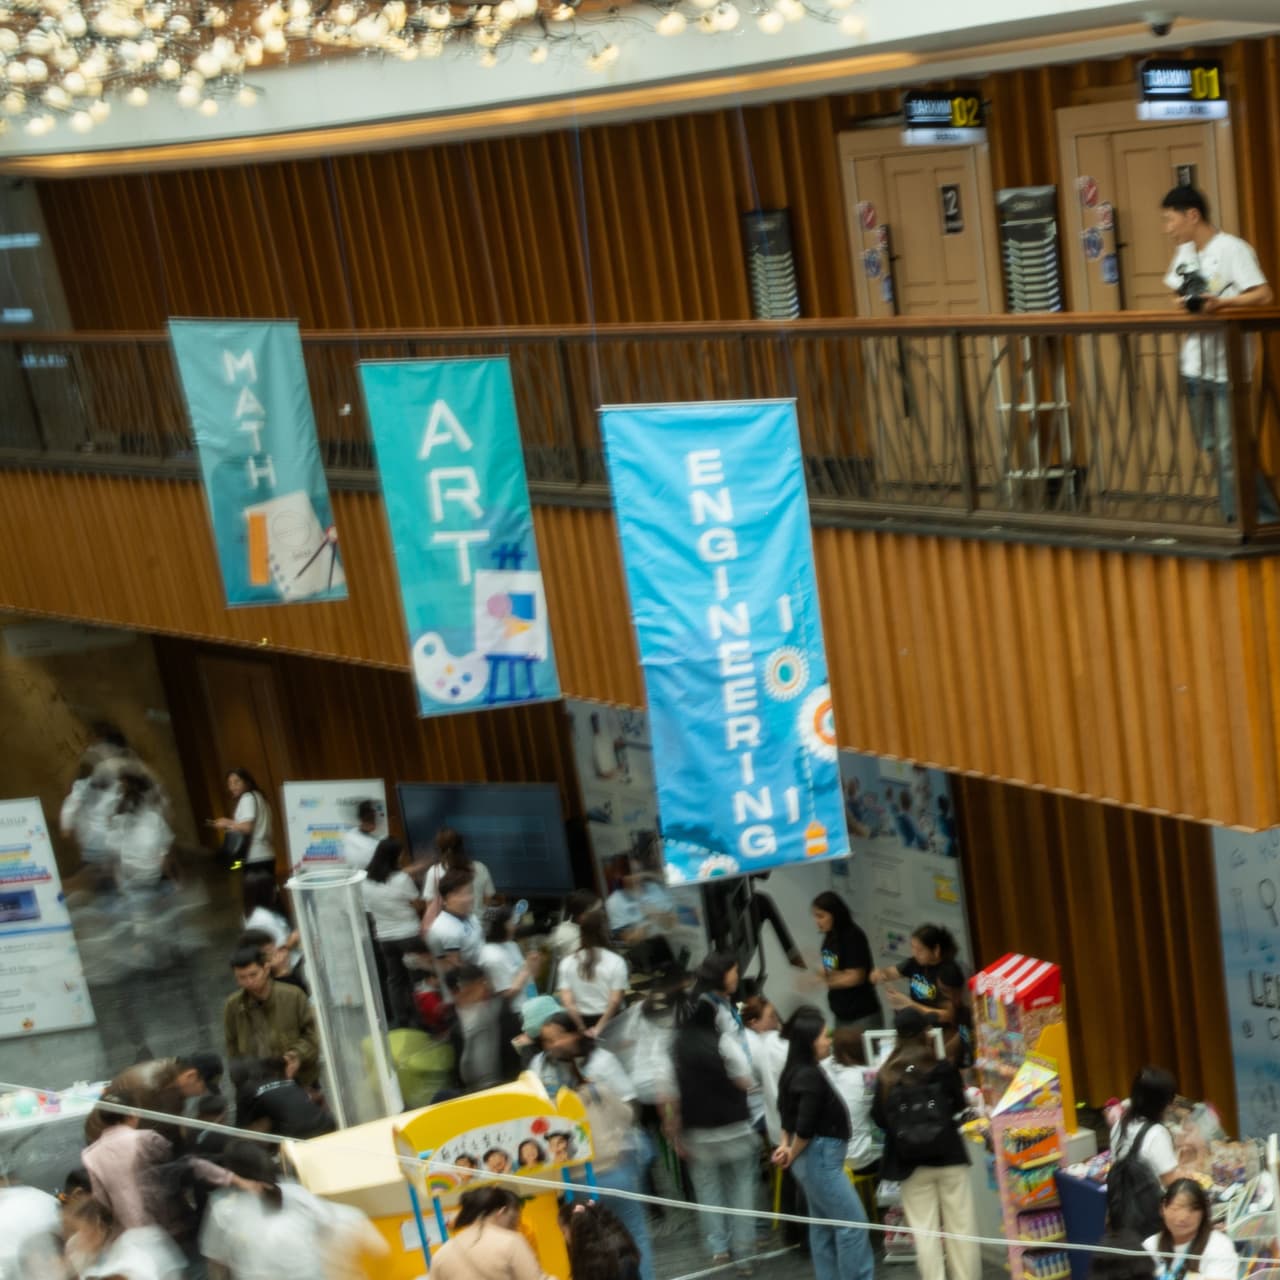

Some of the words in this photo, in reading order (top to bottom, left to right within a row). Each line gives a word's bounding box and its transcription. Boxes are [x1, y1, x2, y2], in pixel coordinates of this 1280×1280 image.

[952, 97, 980, 127] 02
[1191, 67, 1220, 99] 01
[222, 349, 277, 489] MATH
[417, 399, 490, 586] ART
[687, 448, 777, 857] ENGINEERING
